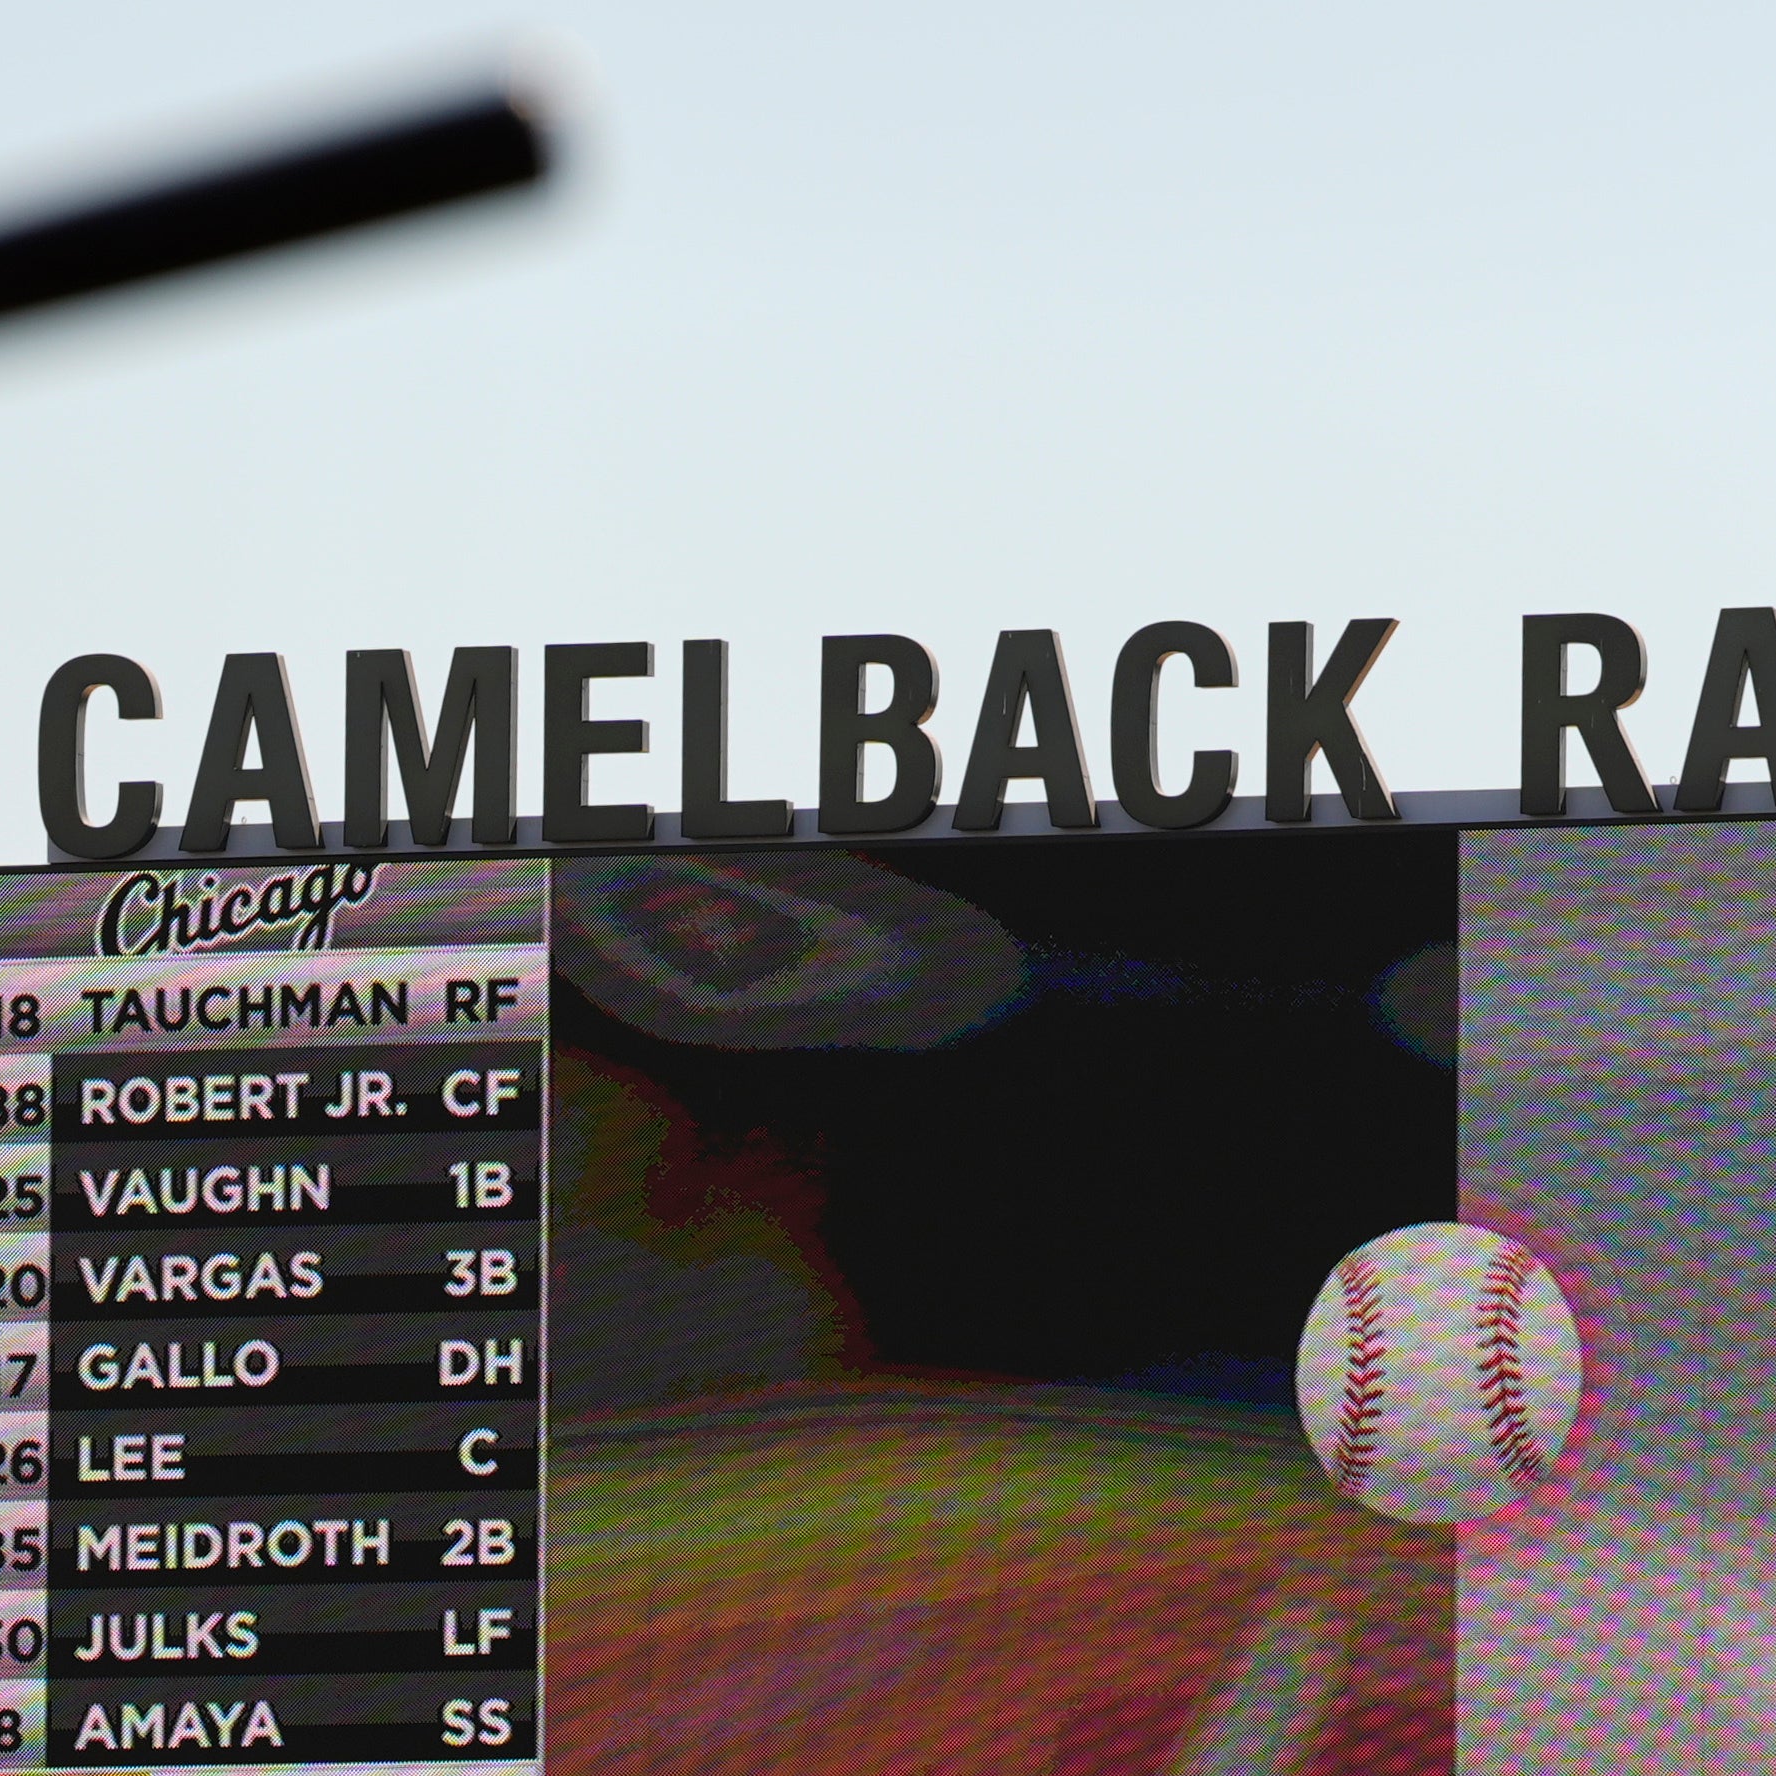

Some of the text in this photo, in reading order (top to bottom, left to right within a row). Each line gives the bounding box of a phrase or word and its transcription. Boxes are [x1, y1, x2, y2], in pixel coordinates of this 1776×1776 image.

[35, 618, 1404, 858] CAMELBACK
[98, 864, 381, 956] Chicago
[82, 981, 408, 1034] TAUCHMAN
[446, 977, 520, 1024] RF
[81, 1072, 311, 1125] ROBERT
[324, 1070, 407, 1118] JR.
[441, 1069, 521, 1117] CF
[78, 1164, 330, 1217] VAUGHN
[449, 1161, 514, 1209] 1B
[78, 1252, 324, 1304] VARGAS
[444, 1249, 520, 1297] 3B
[78, 1340, 281, 1391] GALLO
[439, 1339, 523, 1386] DH
[78, 1434, 187, 1482] LEE
[458, 1428, 499, 1476] C
[77, 1519, 391, 1571] MEIDROTH
[440, 1519, 516, 1566] 2B
[74, 1611, 260, 1661] JULKS
[444, 1607, 513, 1657] LF
[74, 1700, 285, 1751] AMAYA
[441, 1698, 512, 1747] SS
